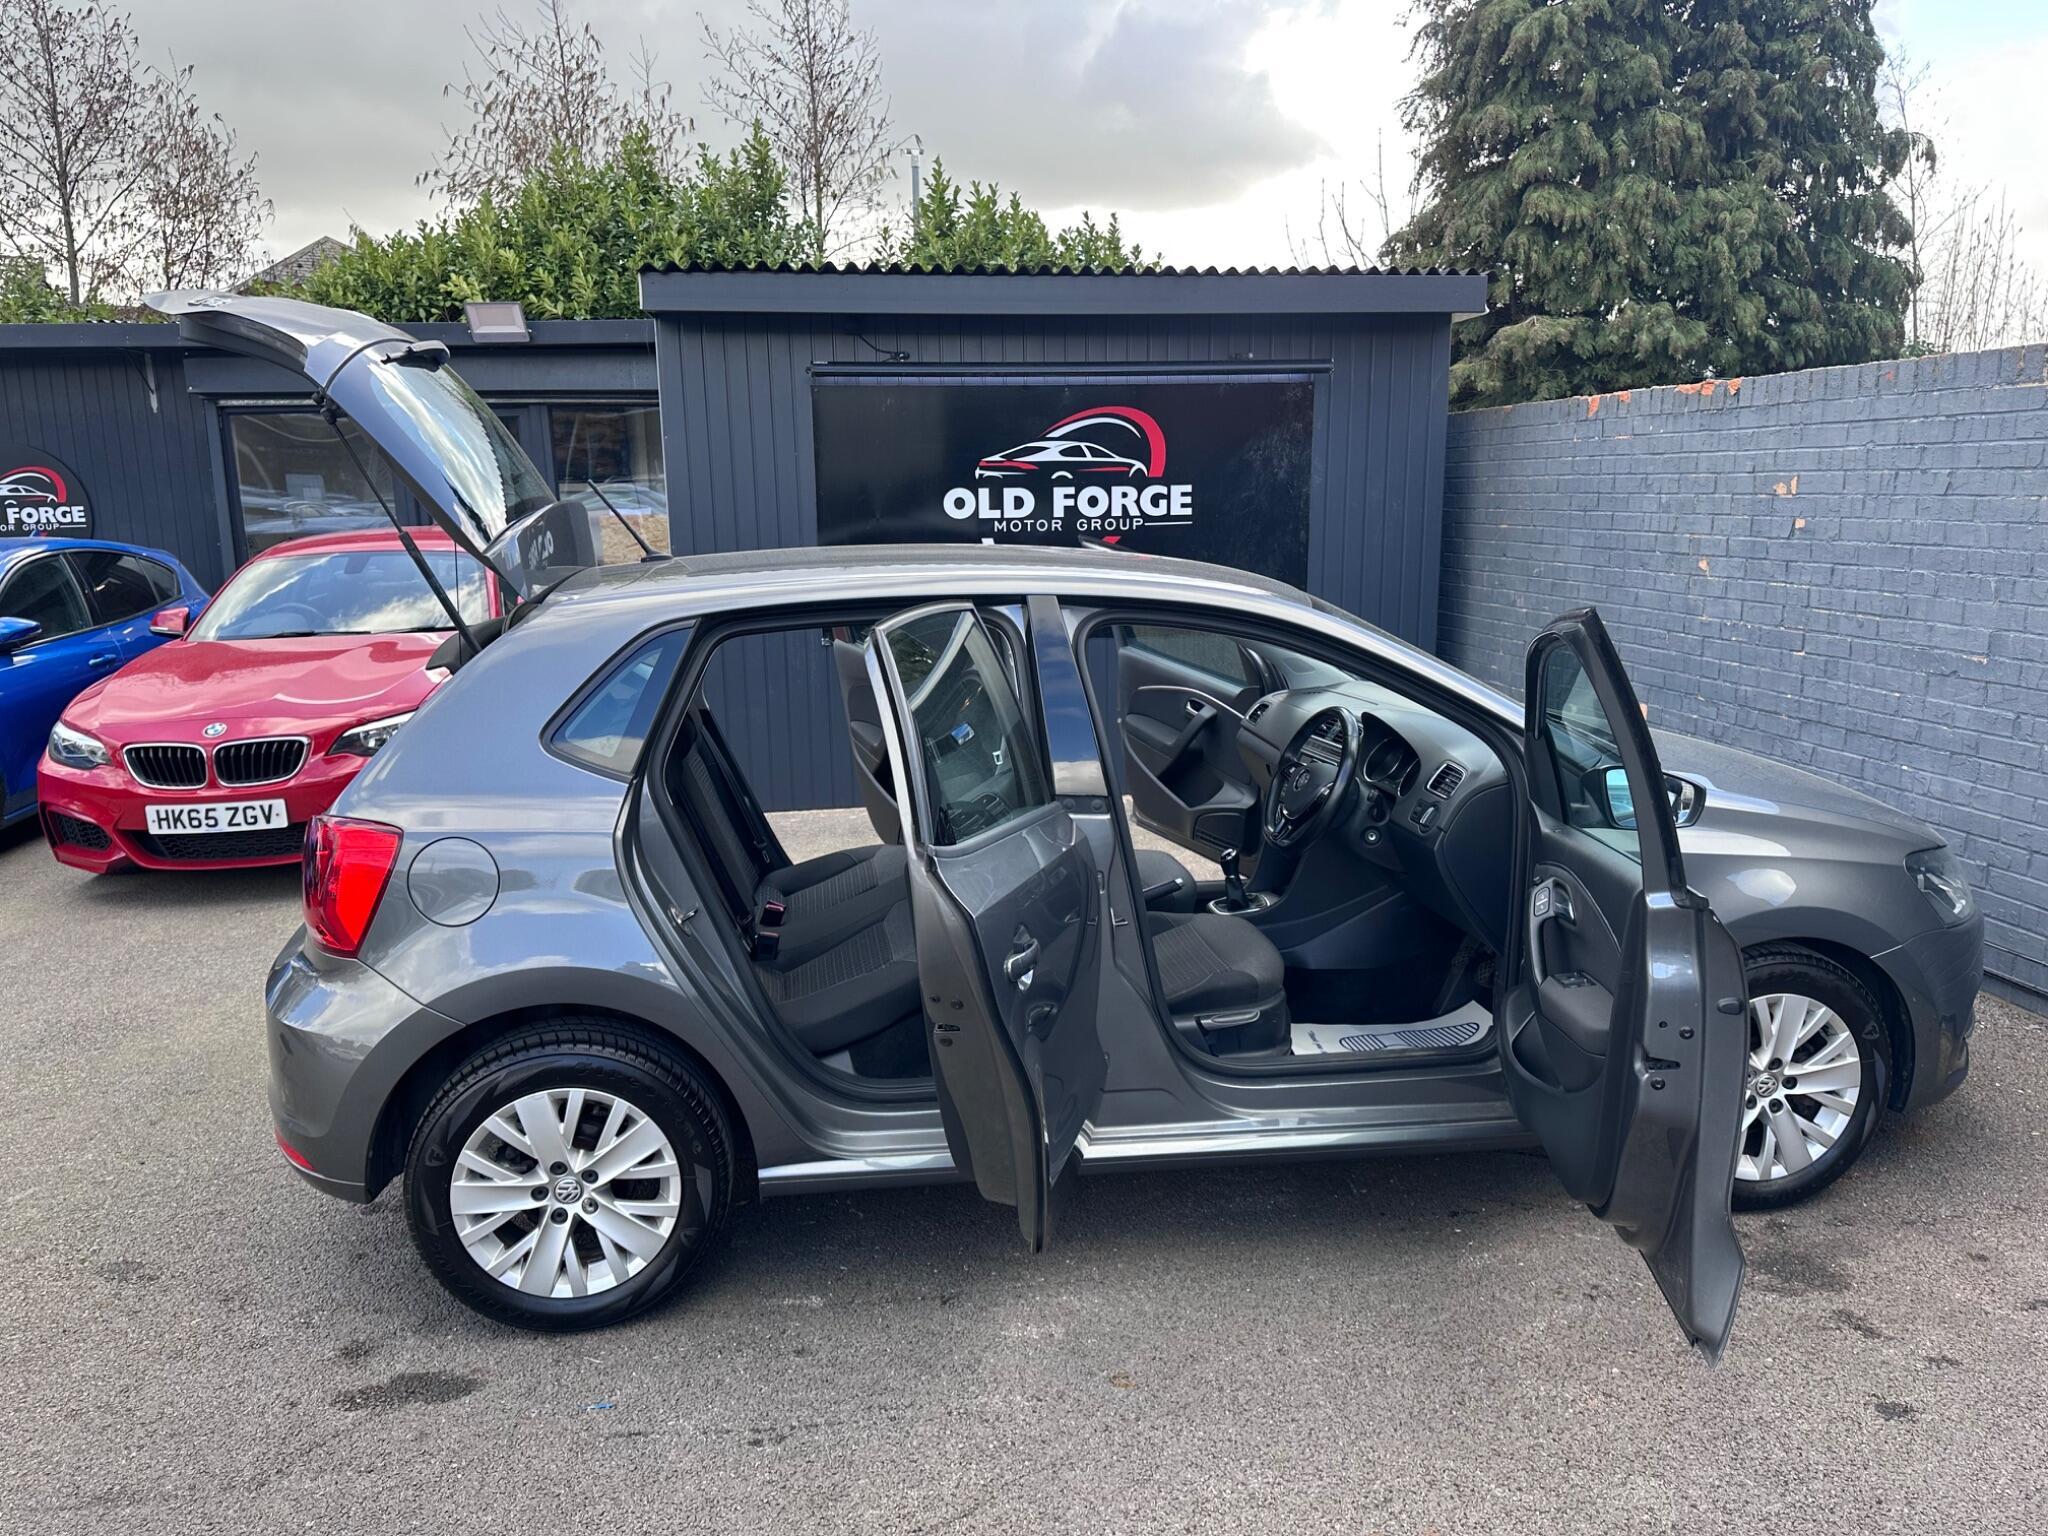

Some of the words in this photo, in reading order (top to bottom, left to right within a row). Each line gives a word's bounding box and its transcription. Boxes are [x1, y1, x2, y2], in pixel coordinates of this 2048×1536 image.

[943, 487, 1035, 519] OLD
[1053, 485, 1192, 517] FORGE
[6, 506, 87, 524] FORGE
[22, 523, 60, 531] GROUP
[994, 519, 1062, 532] MOTOR
[1077, 517, 1144, 531] GROUP
[156, 808, 218, 830] HK65
[224, 804, 273, 827] ZGV
